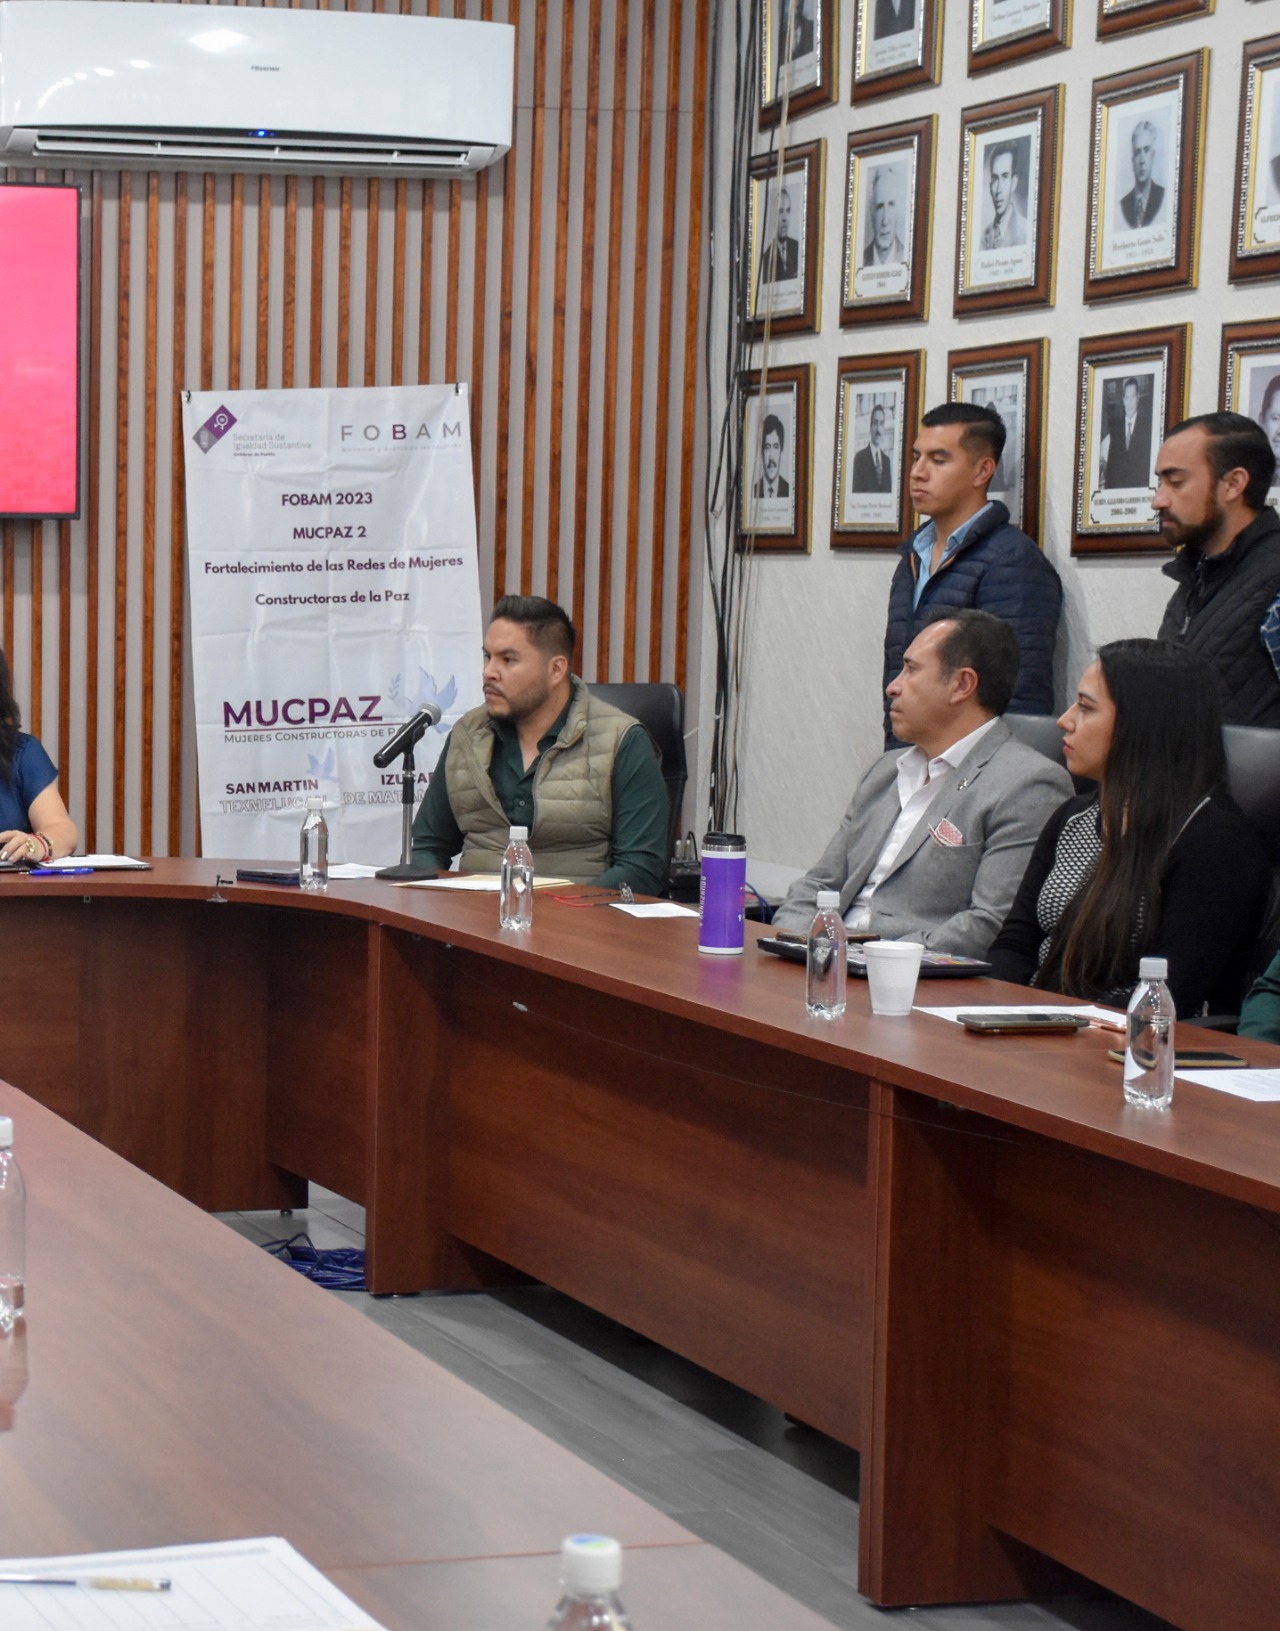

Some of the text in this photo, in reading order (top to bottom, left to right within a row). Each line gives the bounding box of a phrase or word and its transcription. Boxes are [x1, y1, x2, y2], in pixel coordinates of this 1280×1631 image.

[275, 433, 285, 442] de
[341, 421, 462, 442] FOBAM
[233, 441, 311, 451] Igualdad Sustantiva
[282, 492, 373, 506] FOBAM 2023
[293, 525, 367, 539] MUCPAZ 2
[204, 555, 463, 574] Fortalecimiento de las Redes de Mujeres
[255, 590, 410, 605] Constructoras de la Paz
[223, 695, 383, 728] MUCPAZ
[224, 732, 272, 744] MUJERES
[275, 729, 367, 742] CONSTRUCTORAS
[371, 728, 384, 737] DE
[343, 791, 365, 805] DE
